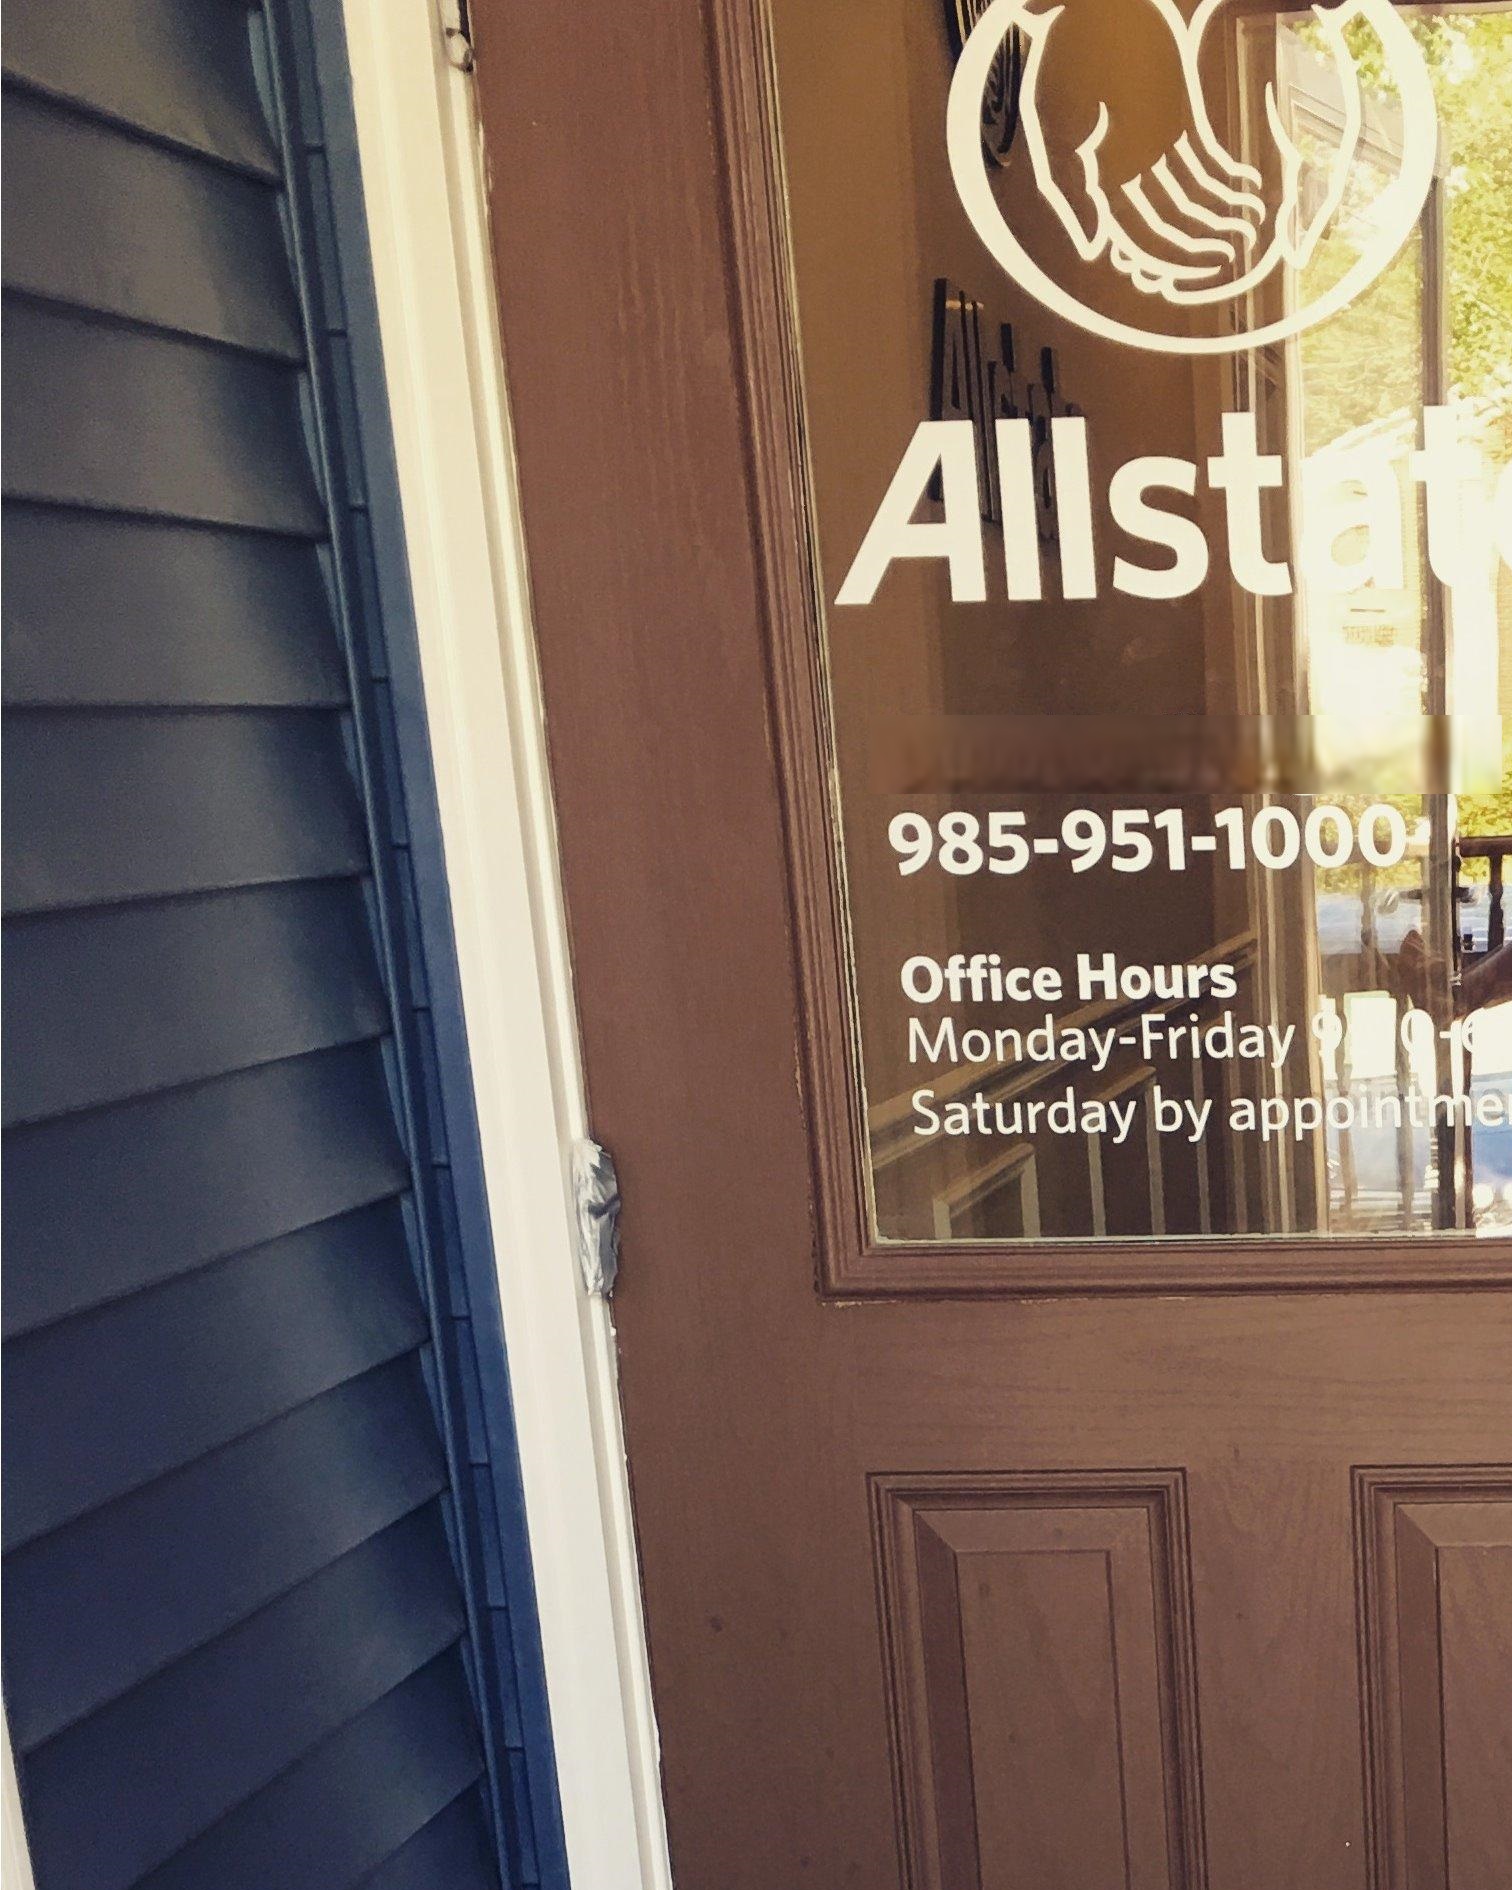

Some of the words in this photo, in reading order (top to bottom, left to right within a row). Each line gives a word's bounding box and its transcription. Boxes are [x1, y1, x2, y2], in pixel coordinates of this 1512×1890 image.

[888, 803, 1406, 877] 985-951-1000
[900, 953, 1063, 1003] Office
[1077, 952, 1238, 1001] Hours
[907, 1010, 1297, 1072] Monday-Friday
[913, 1087, 1137, 1144] Saturday
[1153, 1085, 1213, 1141] by
